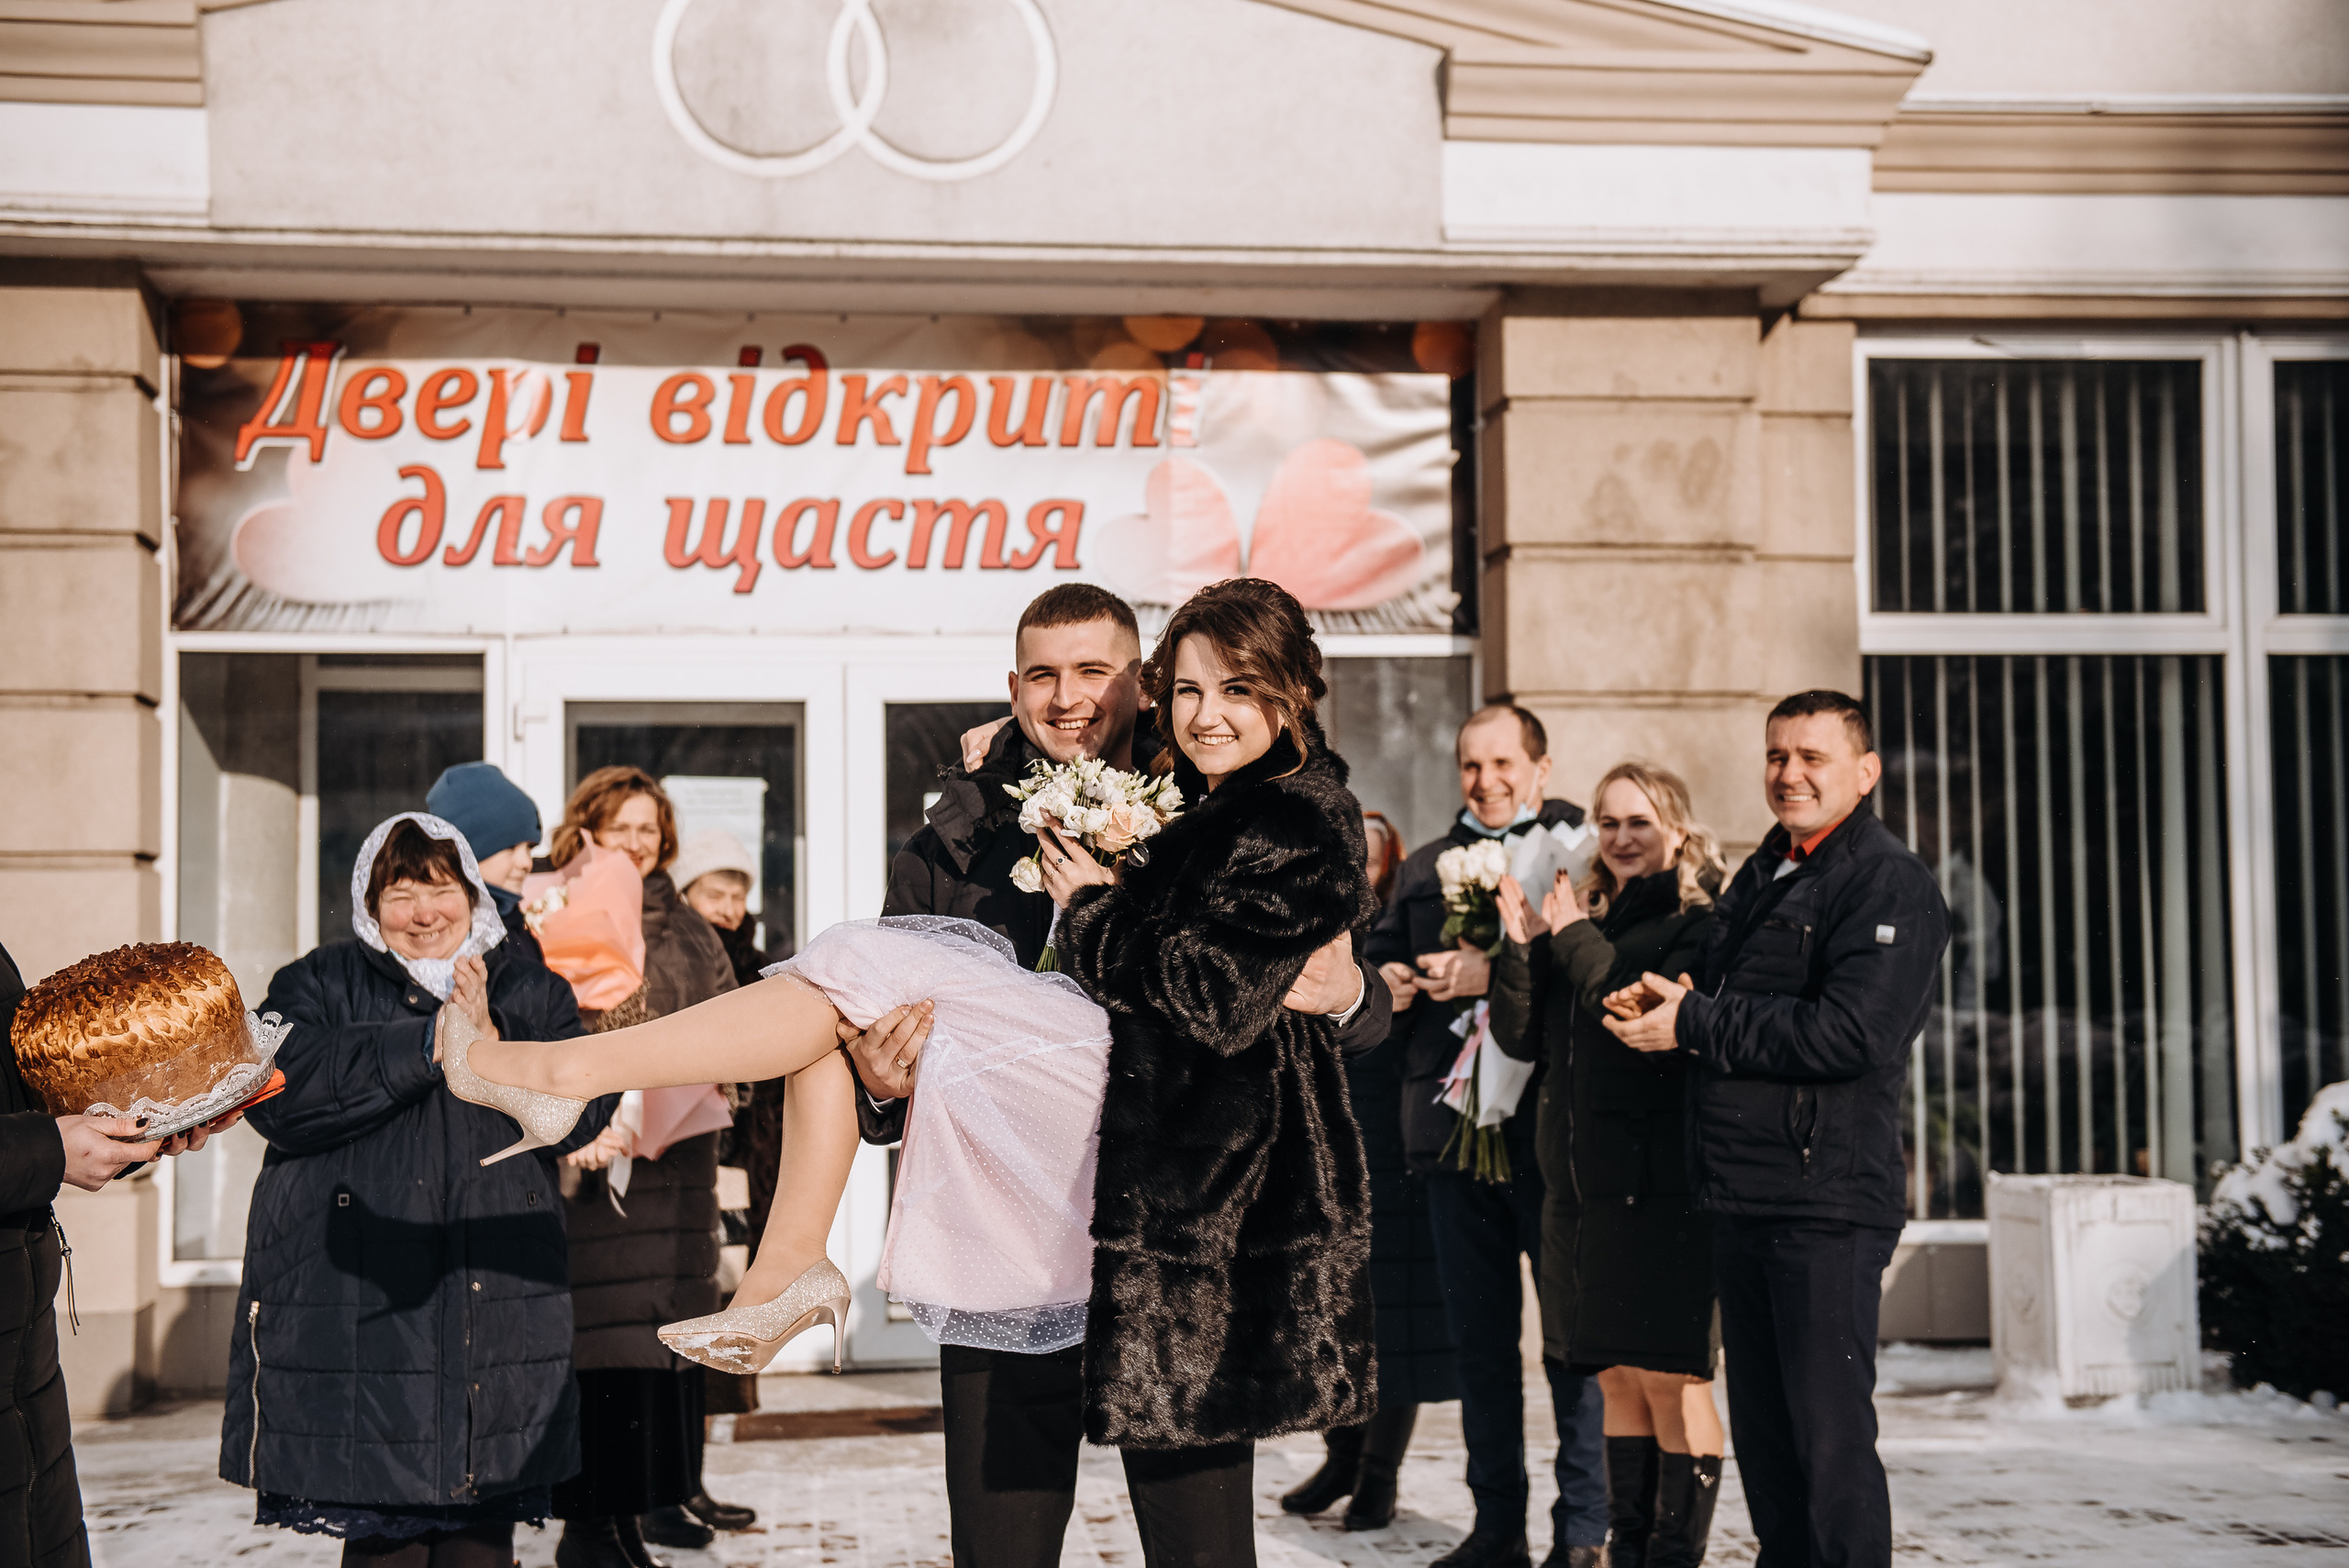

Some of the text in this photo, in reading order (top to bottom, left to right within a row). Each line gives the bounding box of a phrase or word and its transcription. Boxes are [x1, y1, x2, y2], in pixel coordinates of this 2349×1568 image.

[235, 341, 600, 470] Двері
[376, 463, 1085, 594] для щастя
